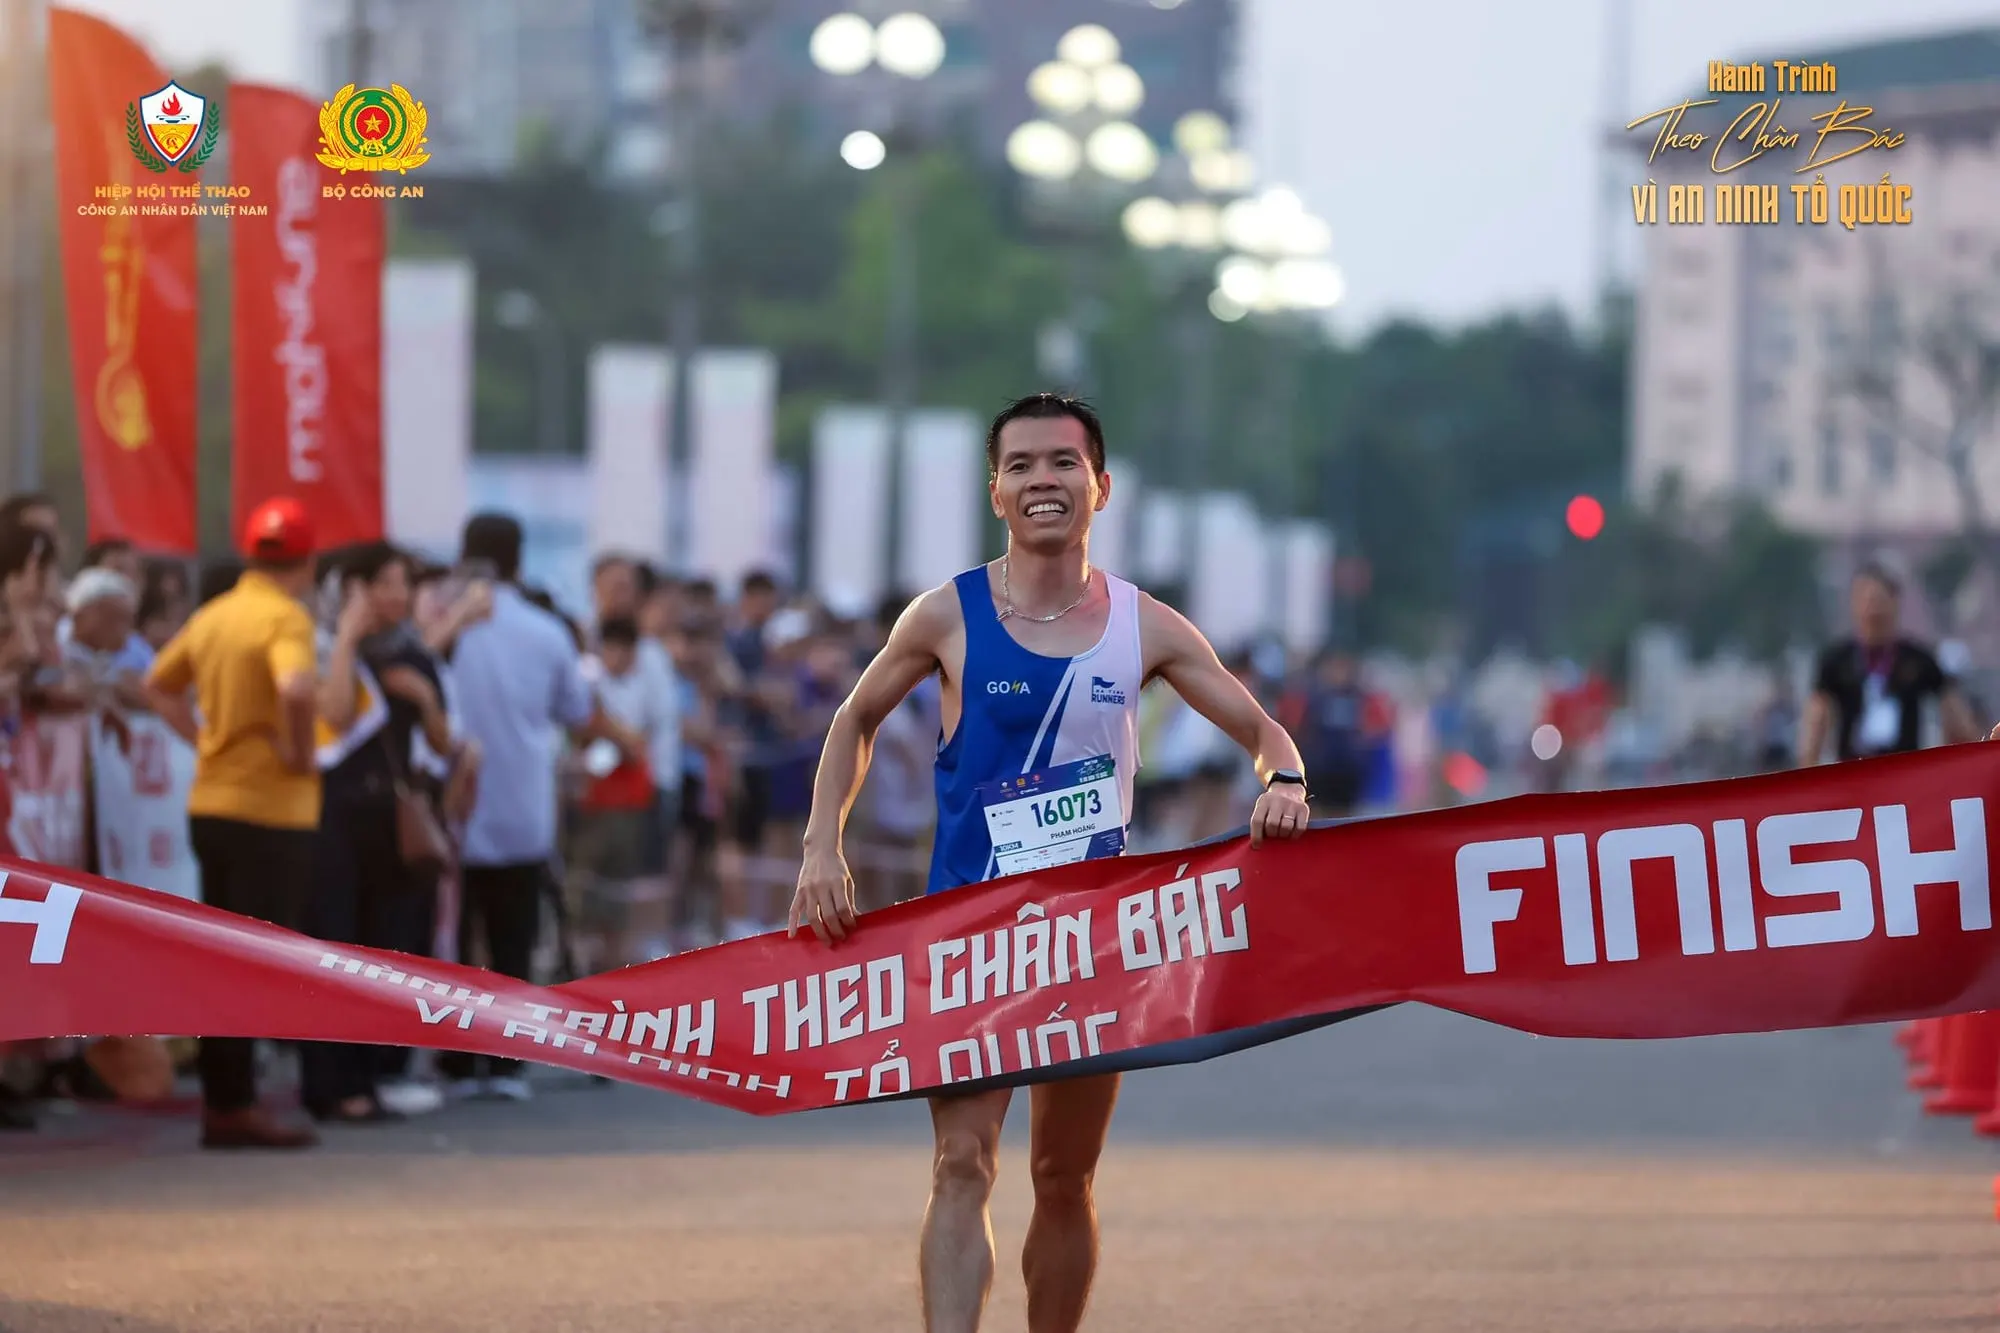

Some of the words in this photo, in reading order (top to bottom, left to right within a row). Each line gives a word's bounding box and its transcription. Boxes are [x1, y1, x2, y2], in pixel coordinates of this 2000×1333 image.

[1030, 788, 1102, 828] 16073
[1455, 797, 1992, 975] FINISH
[524, 998, 715, 1057] TRÌNH
[742, 954, 906, 1056] THEO
[1117, 862, 1250, 972] BÁC
[824, 1038, 911, 1101] TỔ
